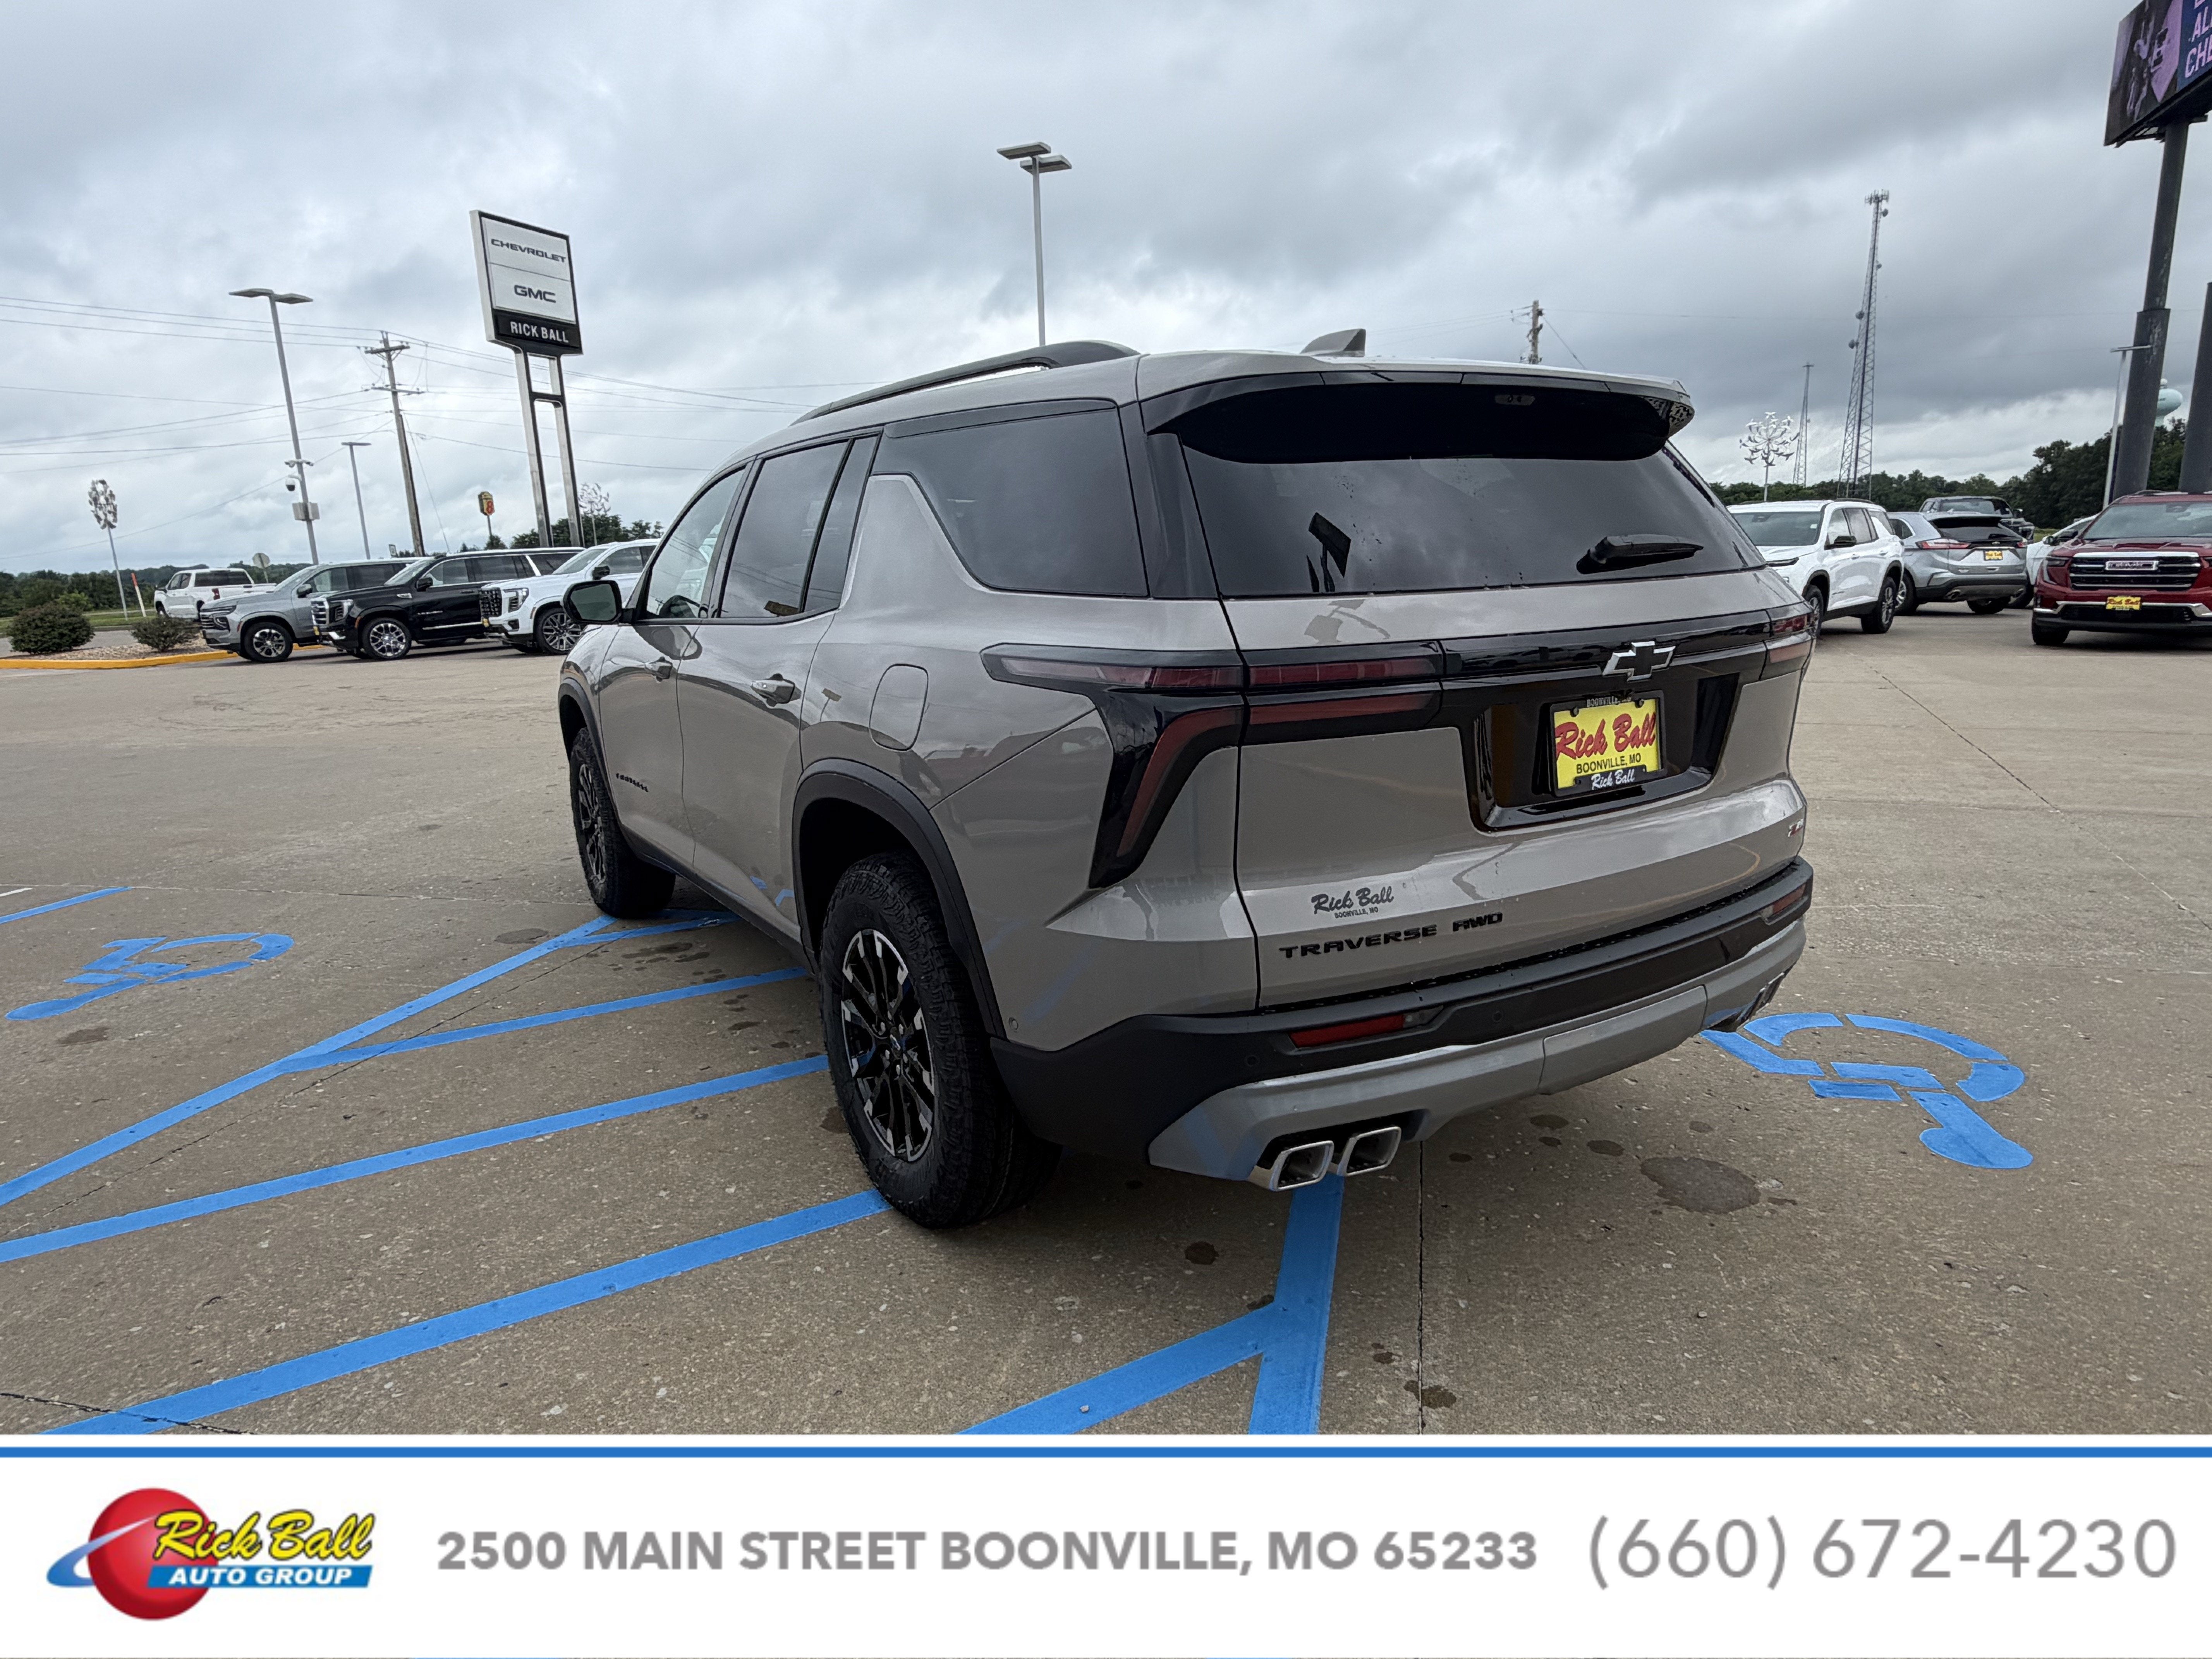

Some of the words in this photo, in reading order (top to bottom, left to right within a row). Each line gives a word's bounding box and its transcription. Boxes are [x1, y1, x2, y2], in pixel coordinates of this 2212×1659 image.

[491, 239, 566, 263] CHEVROLET
[514, 285, 556, 303] GMC
[510, 321, 539, 338] RICK
[541, 327, 569, 343] BALL
[1555, 718, 1608, 761] Rick
[1613, 712, 1656, 752] Ball
[1576, 756, 1627, 774] BOONVILLE,
[1629, 752, 1641, 764] MO
[1591, 771, 1613, 791] Rick
[1614, 769, 1635, 784] Ball
[1310, 891, 1353, 914] Rick
[1355, 886, 1394, 907] Ball
[1279, 924, 1437, 958] TRAVERSE
[1452, 912, 1503, 932] AWD
